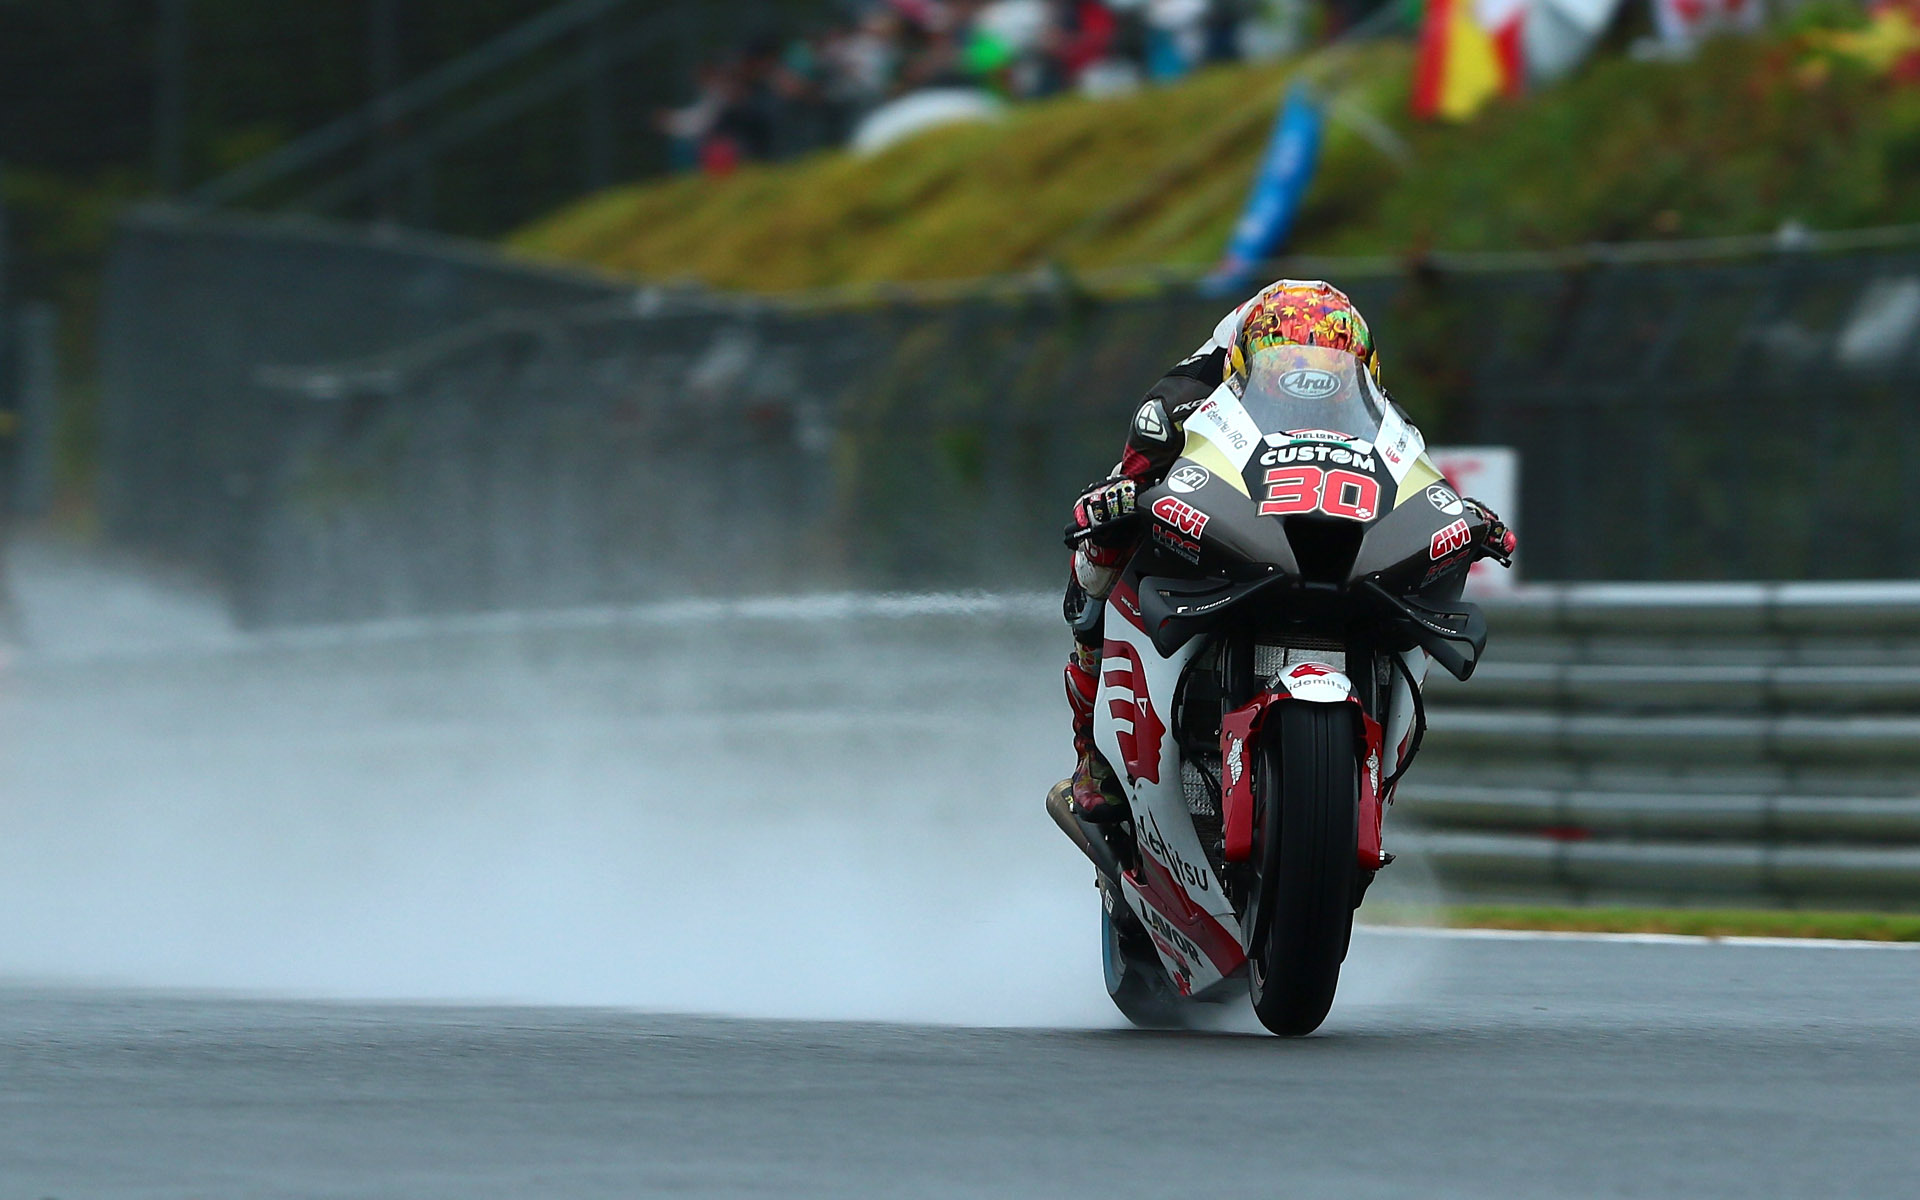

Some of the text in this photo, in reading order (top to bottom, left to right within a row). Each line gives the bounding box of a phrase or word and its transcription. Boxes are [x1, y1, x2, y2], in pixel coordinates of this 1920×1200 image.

[1283, 373, 1332, 389] Arai
[1260, 445, 1376, 473] CUSTOM
[1175, 468, 1206, 487] SIFI
[1258, 466, 1380, 522] 30
[1152, 496, 1210, 540] GIVI
[1430, 518, 1471, 560] GIVI
[1289, 678, 1350, 693] idemitsu
